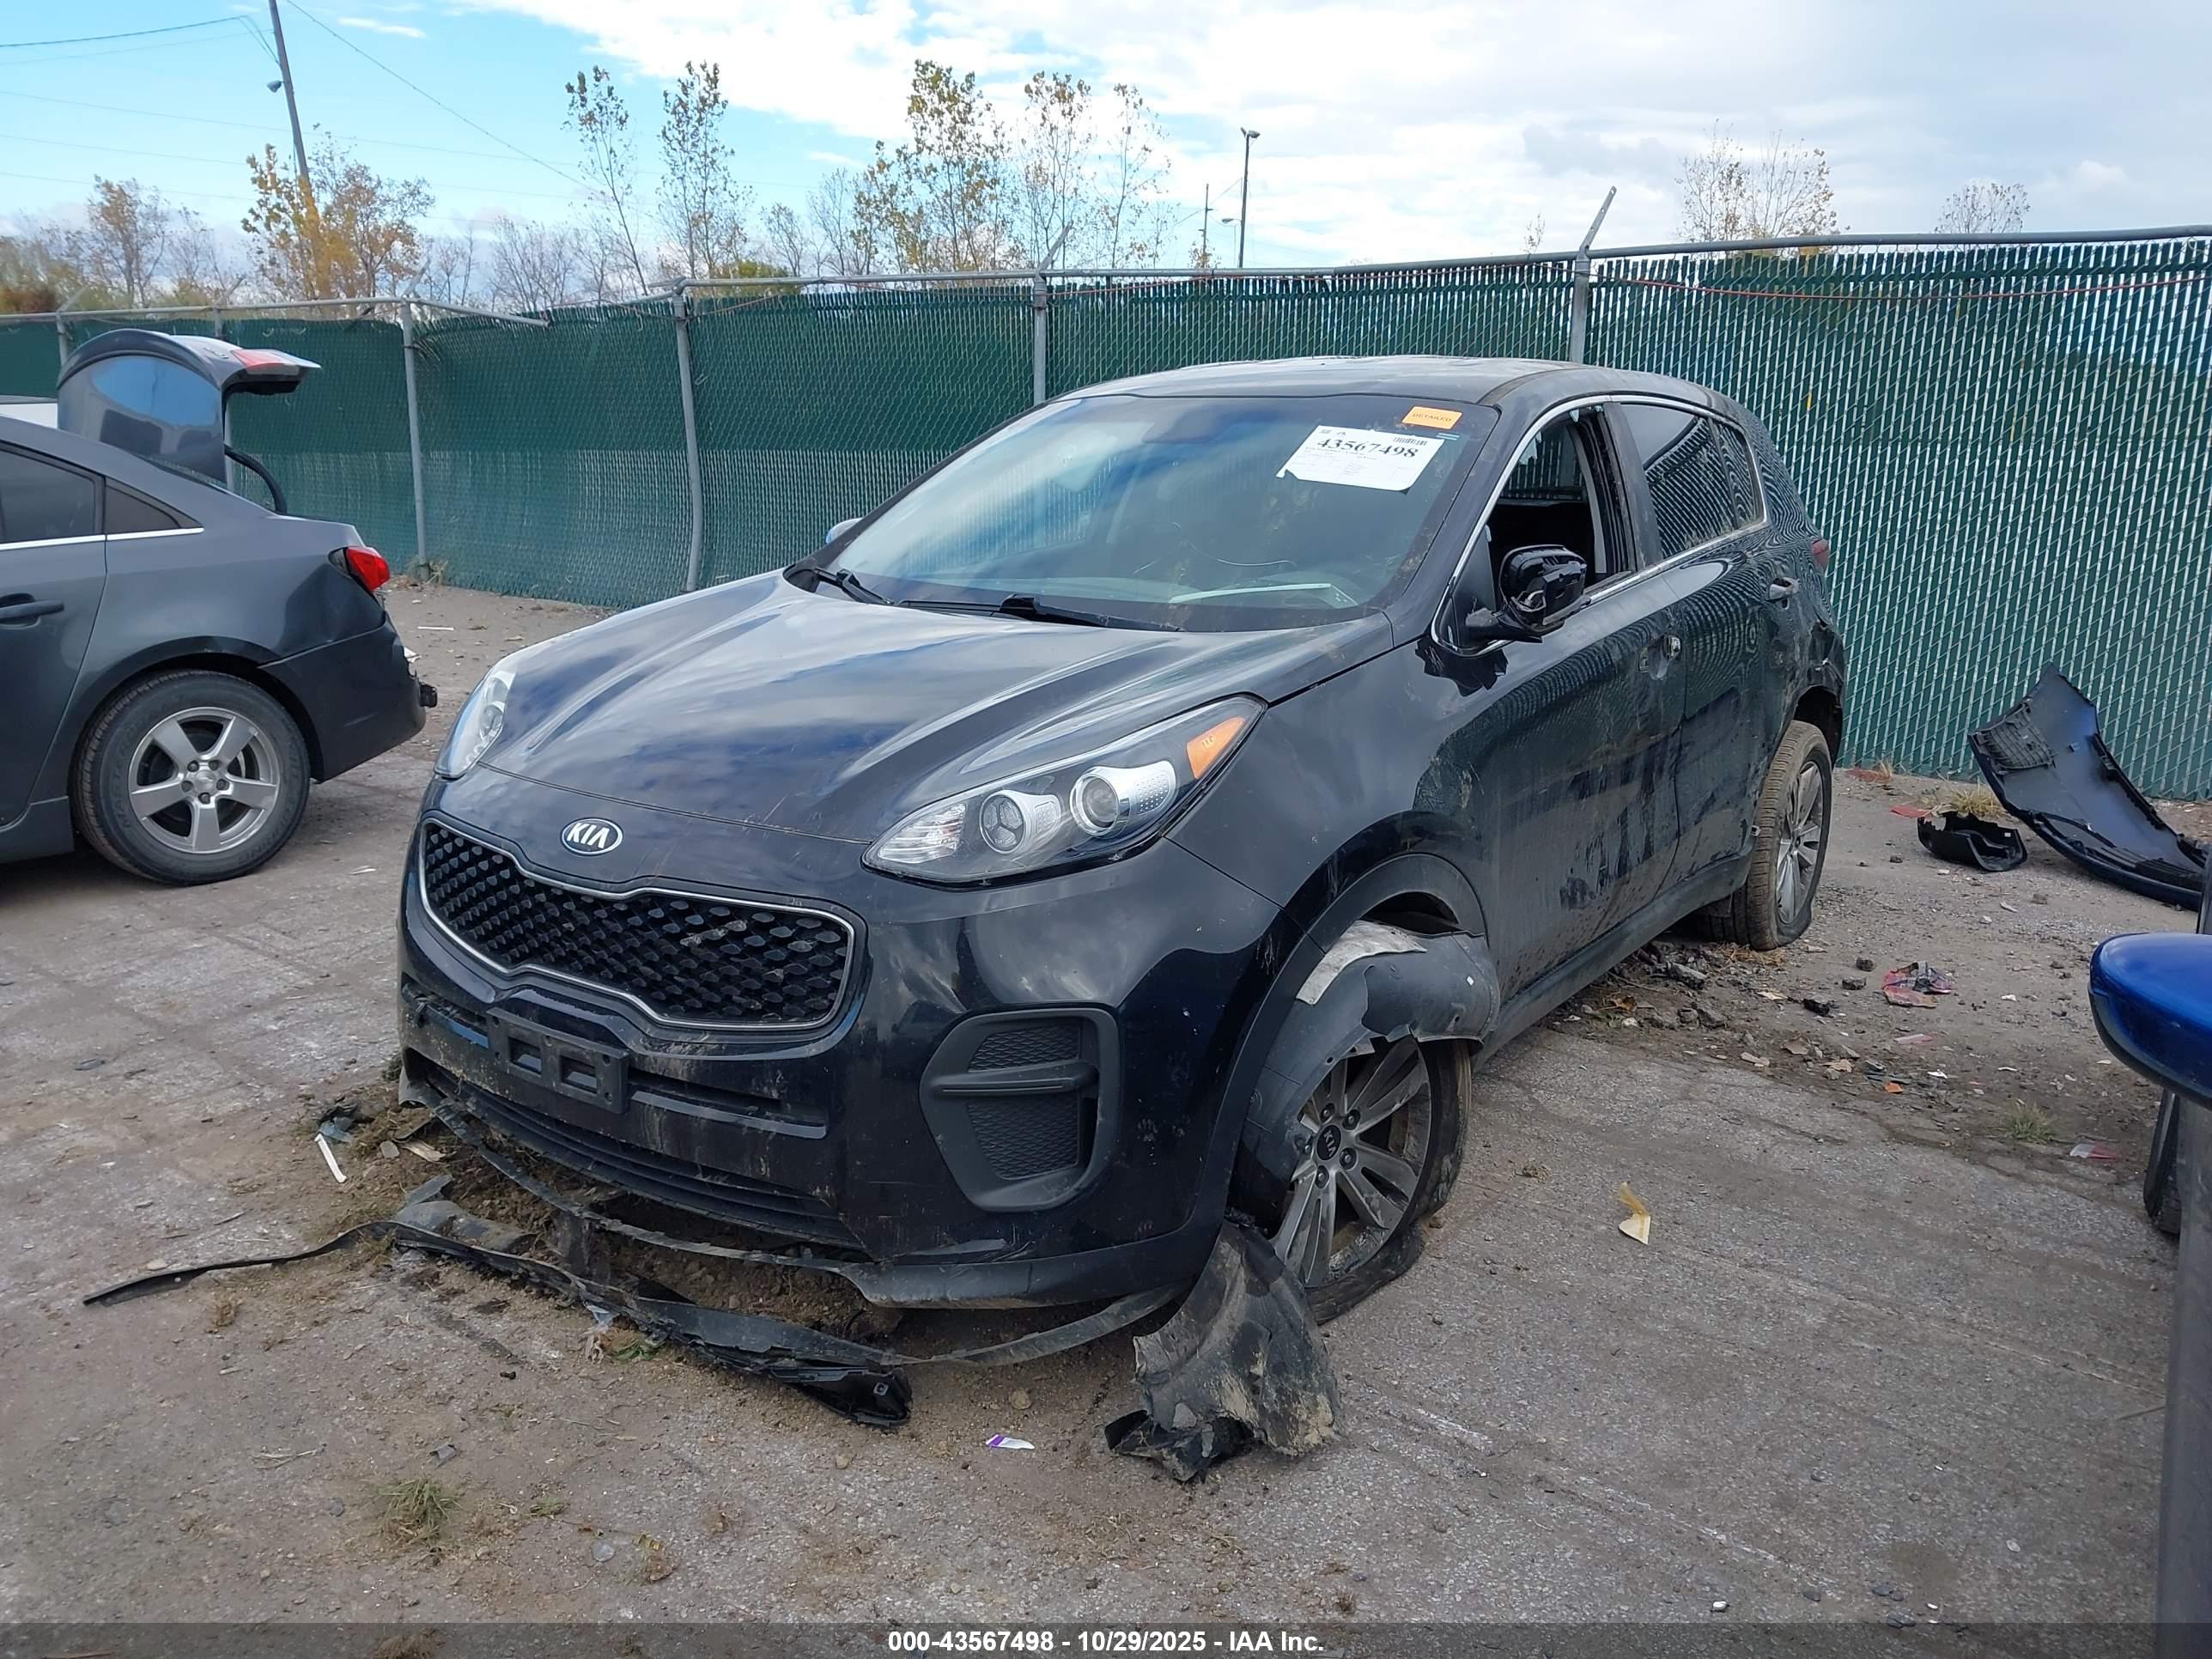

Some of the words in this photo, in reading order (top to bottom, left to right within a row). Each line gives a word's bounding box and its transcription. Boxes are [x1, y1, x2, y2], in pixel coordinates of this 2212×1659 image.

[1411, 412, 1453, 422] DETAILED
[1316, 438, 1419, 459] 43567498
[566, 822, 611, 849] KIA
[1322, 1129, 1337, 1158] KIA
